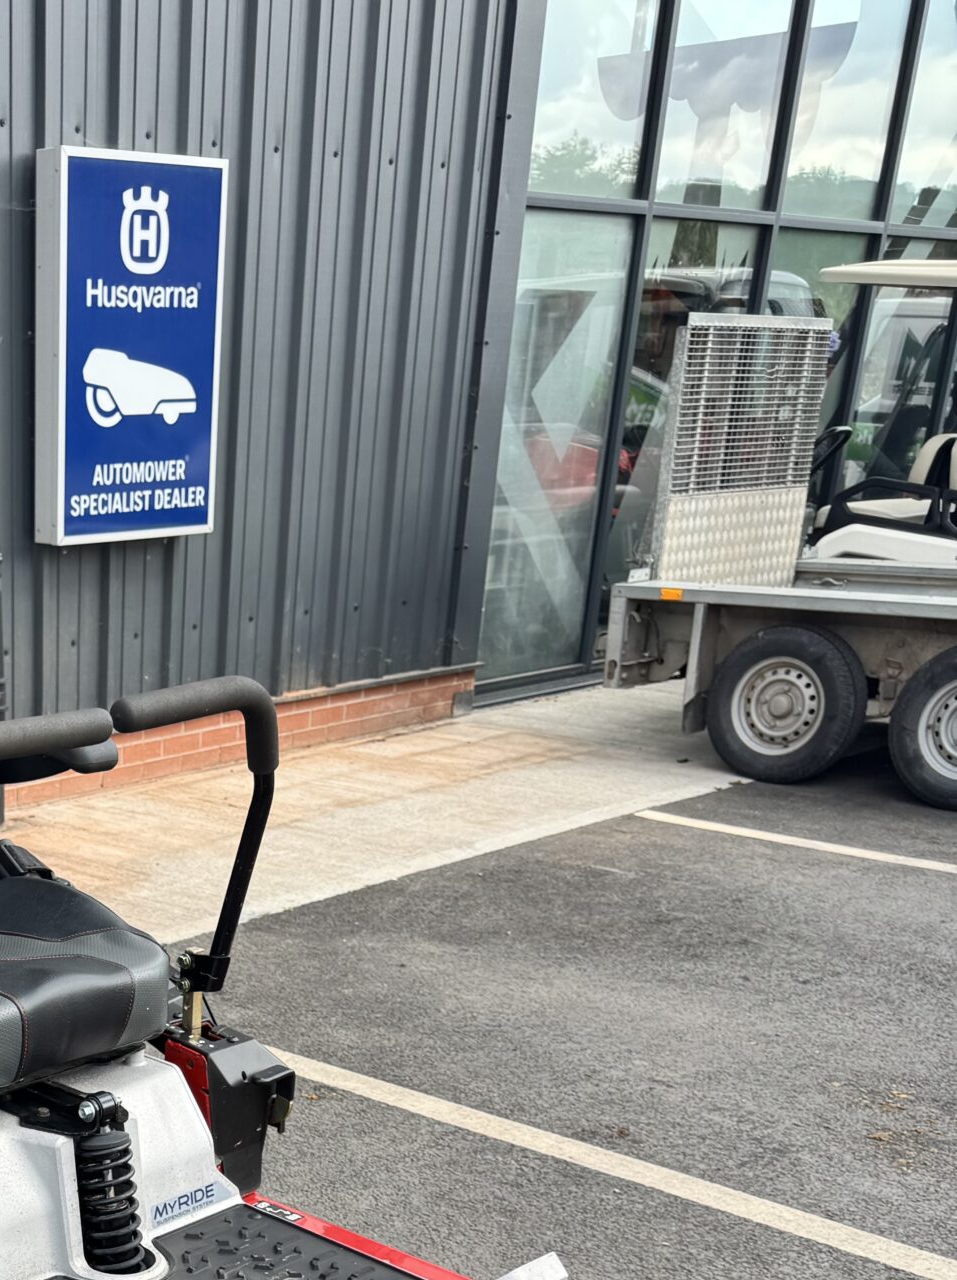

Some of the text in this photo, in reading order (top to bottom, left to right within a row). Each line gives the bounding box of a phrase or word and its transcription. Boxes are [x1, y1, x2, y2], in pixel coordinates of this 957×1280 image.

[132, 214, 158, 258] H
[85, 278, 199, 313] Husqvarna
[92, 459, 186, 486] AUTOMOWER
[70, 486, 205, 517] SPECIALIST DEALER
